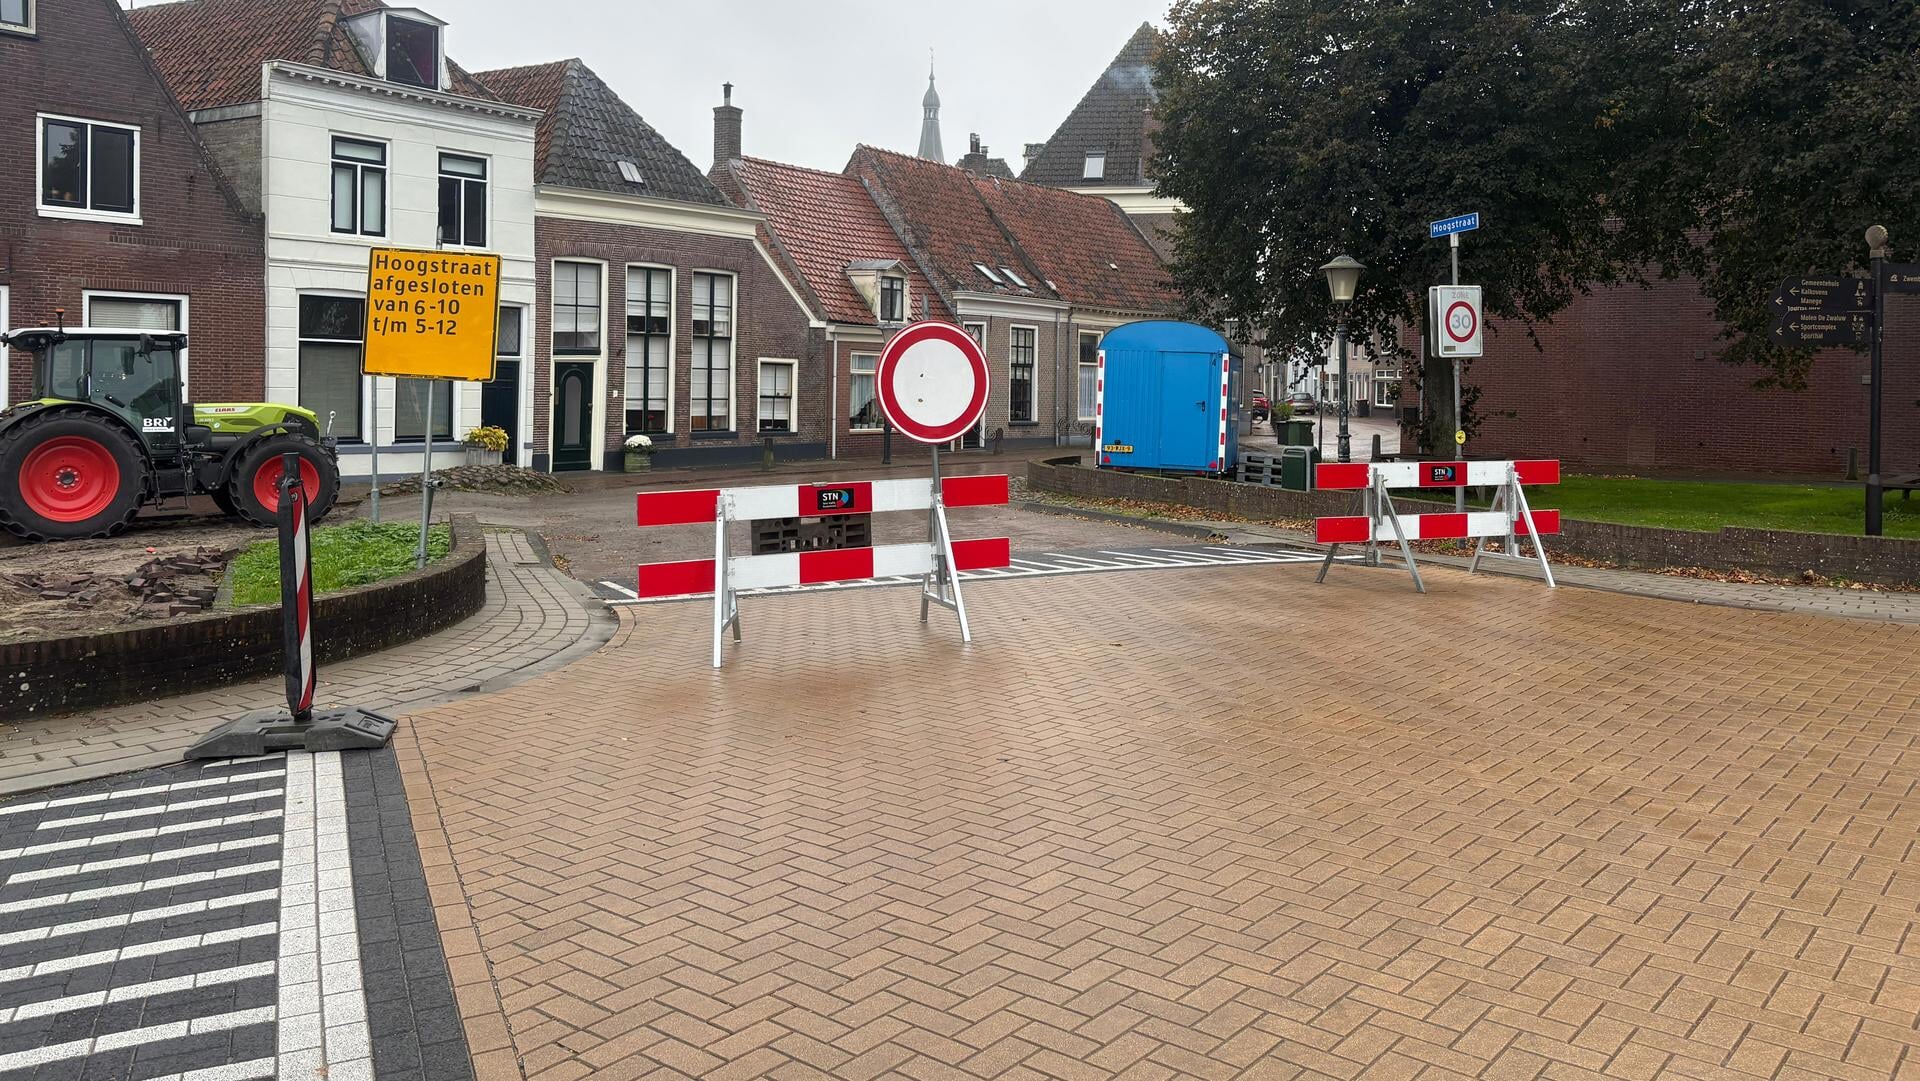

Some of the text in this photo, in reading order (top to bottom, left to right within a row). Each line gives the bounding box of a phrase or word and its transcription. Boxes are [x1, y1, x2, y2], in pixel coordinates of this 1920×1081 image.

[1432, 216, 1475, 232] Hoogstraat
[375, 254, 491, 276] Hoogstraat
[373, 275, 484, 296] afgesloten
[1801, 279, 1840, 287] Gemeentehuis
[1451, 291, 1469, 299] ZONE
[1800, 297, 1823, 306] Manege
[374, 299, 460, 315] van 6-10
[373, 316, 457, 336] t/m 5-12
[1451, 314, 1471, 329] 30
[1800, 324, 1837, 332] Sportcomplex
[1800, 332, 1824, 340] Sporthal
[1434, 468, 1446, 476] STN
[822, 492, 839, 502] STN
